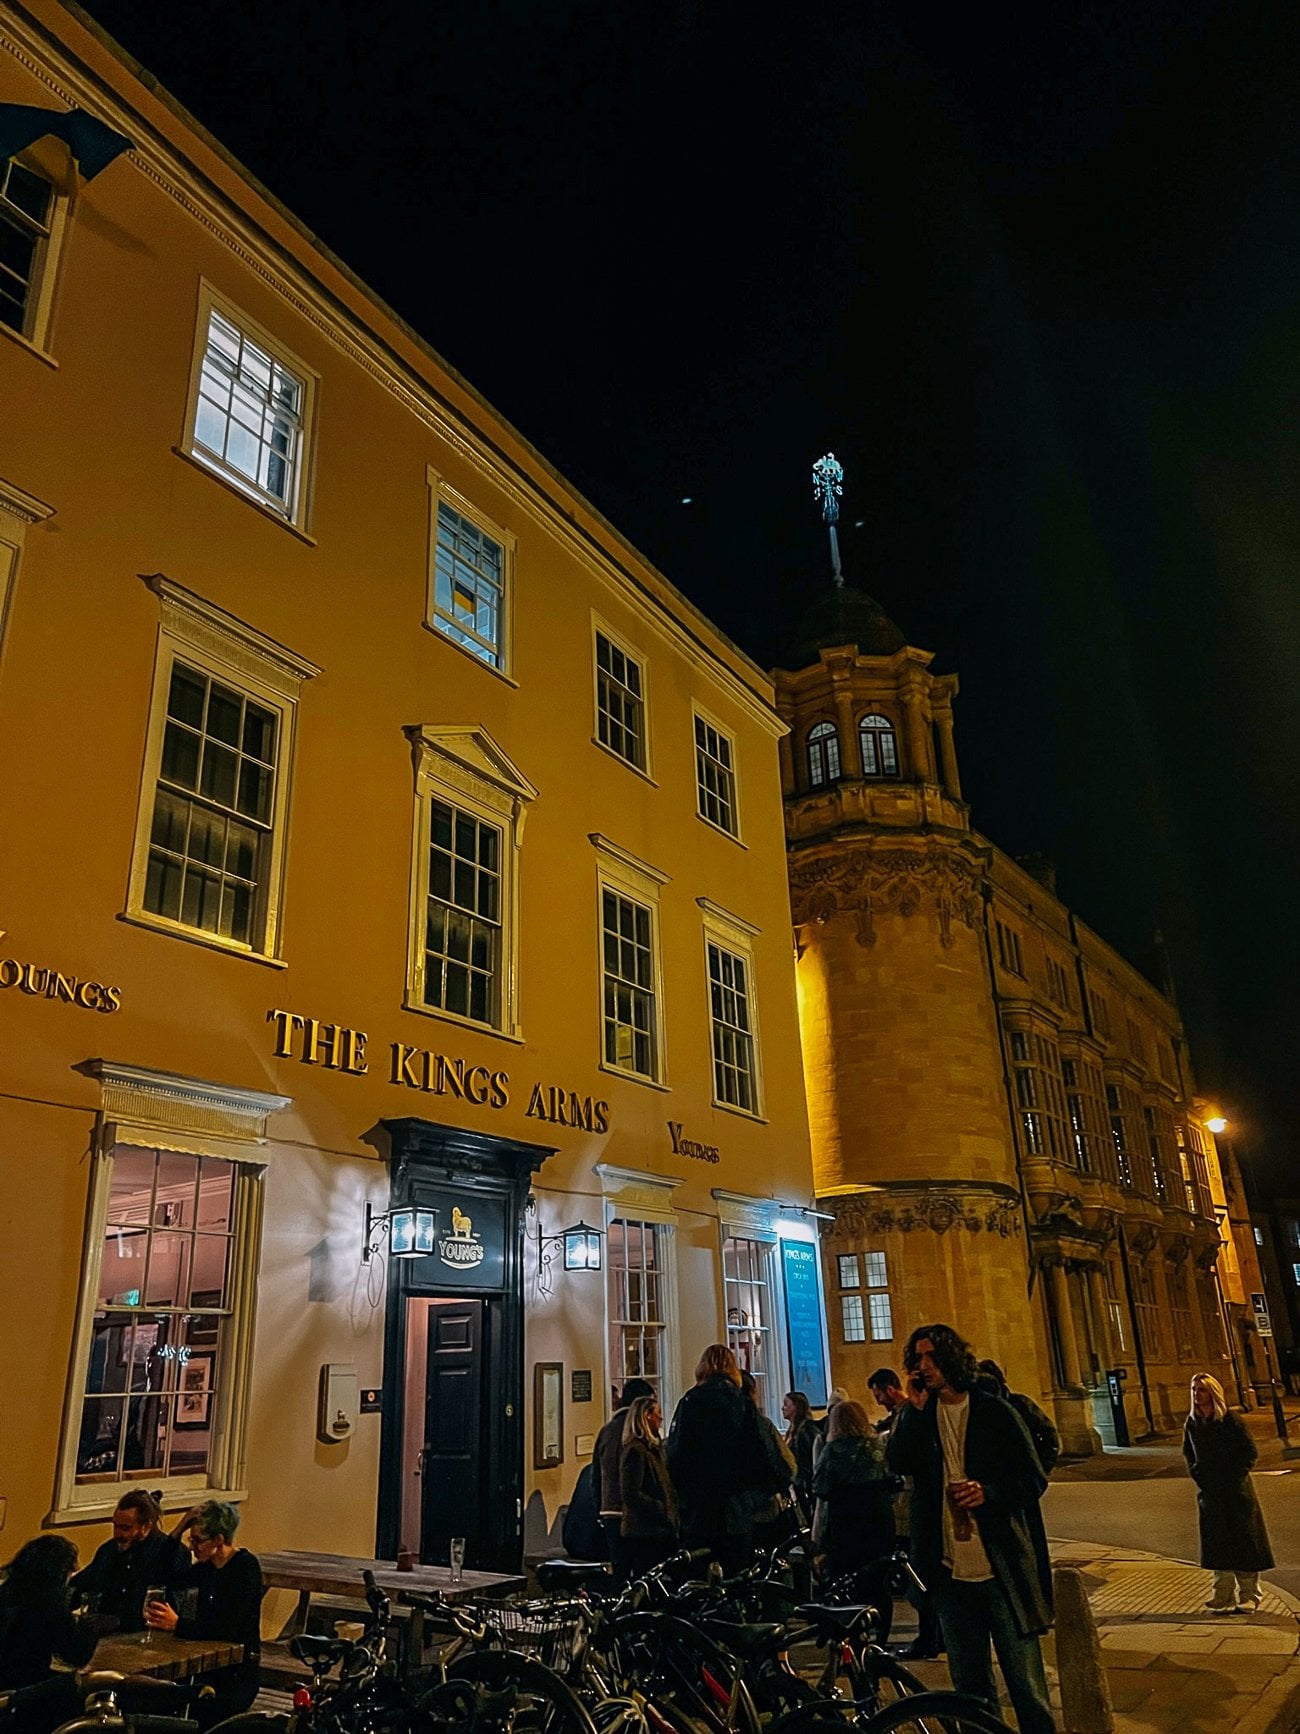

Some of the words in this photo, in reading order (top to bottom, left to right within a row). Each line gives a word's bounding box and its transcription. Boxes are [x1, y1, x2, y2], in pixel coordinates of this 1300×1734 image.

[0, 931, 122, 1013] OUNGS
[267, 1008, 369, 1075] THE
[389, 1042, 510, 1108] KINGS
[525, 1082, 609, 1134] ARMS
[438, 1240, 484, 1261] YOUNG'S
